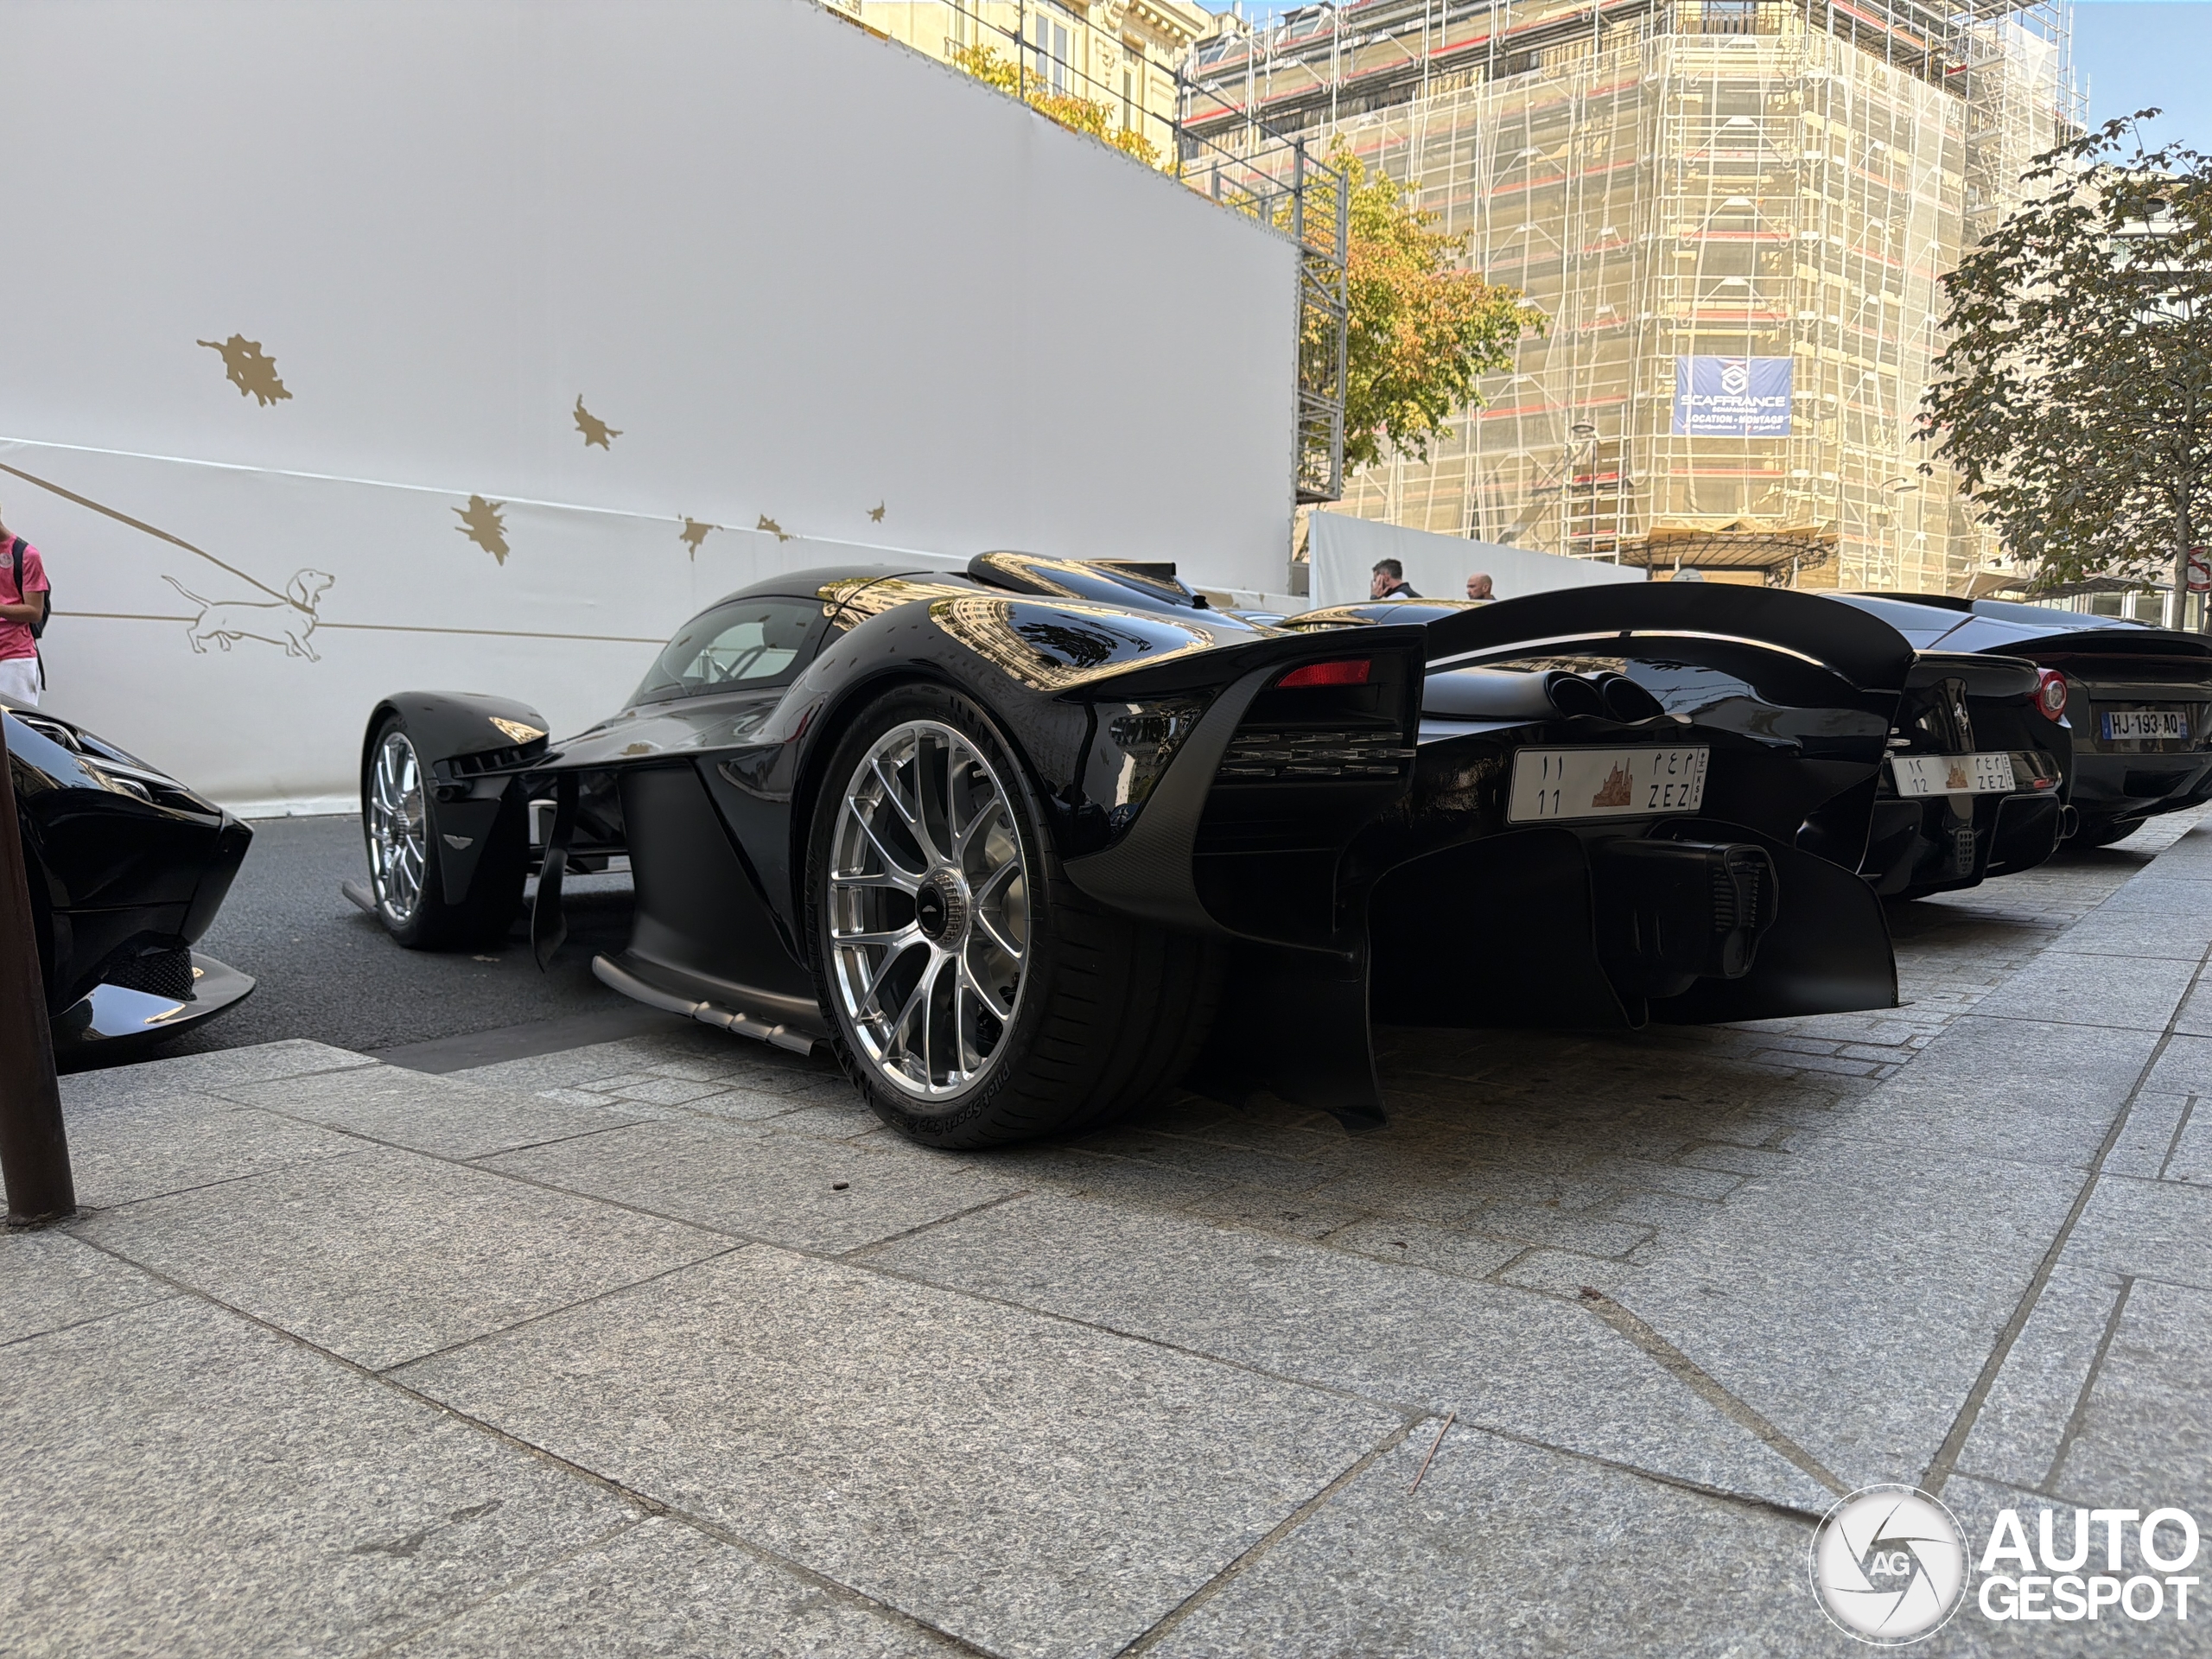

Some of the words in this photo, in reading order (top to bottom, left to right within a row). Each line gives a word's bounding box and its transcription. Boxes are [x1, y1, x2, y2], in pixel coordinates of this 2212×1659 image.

[1681, 395, 1785, 407] SCAFFRANCE
[1738, 415, 1784, 423] MONTAGE
[1912, 778, 1929, 793] 12
[1978, 774, 2006, 790] ZEZ
[1537, 789, 1560, 815] 11
[1648, 784, 1689, 809] ZEZ
[945, 1097, 982, 1133] Sport
